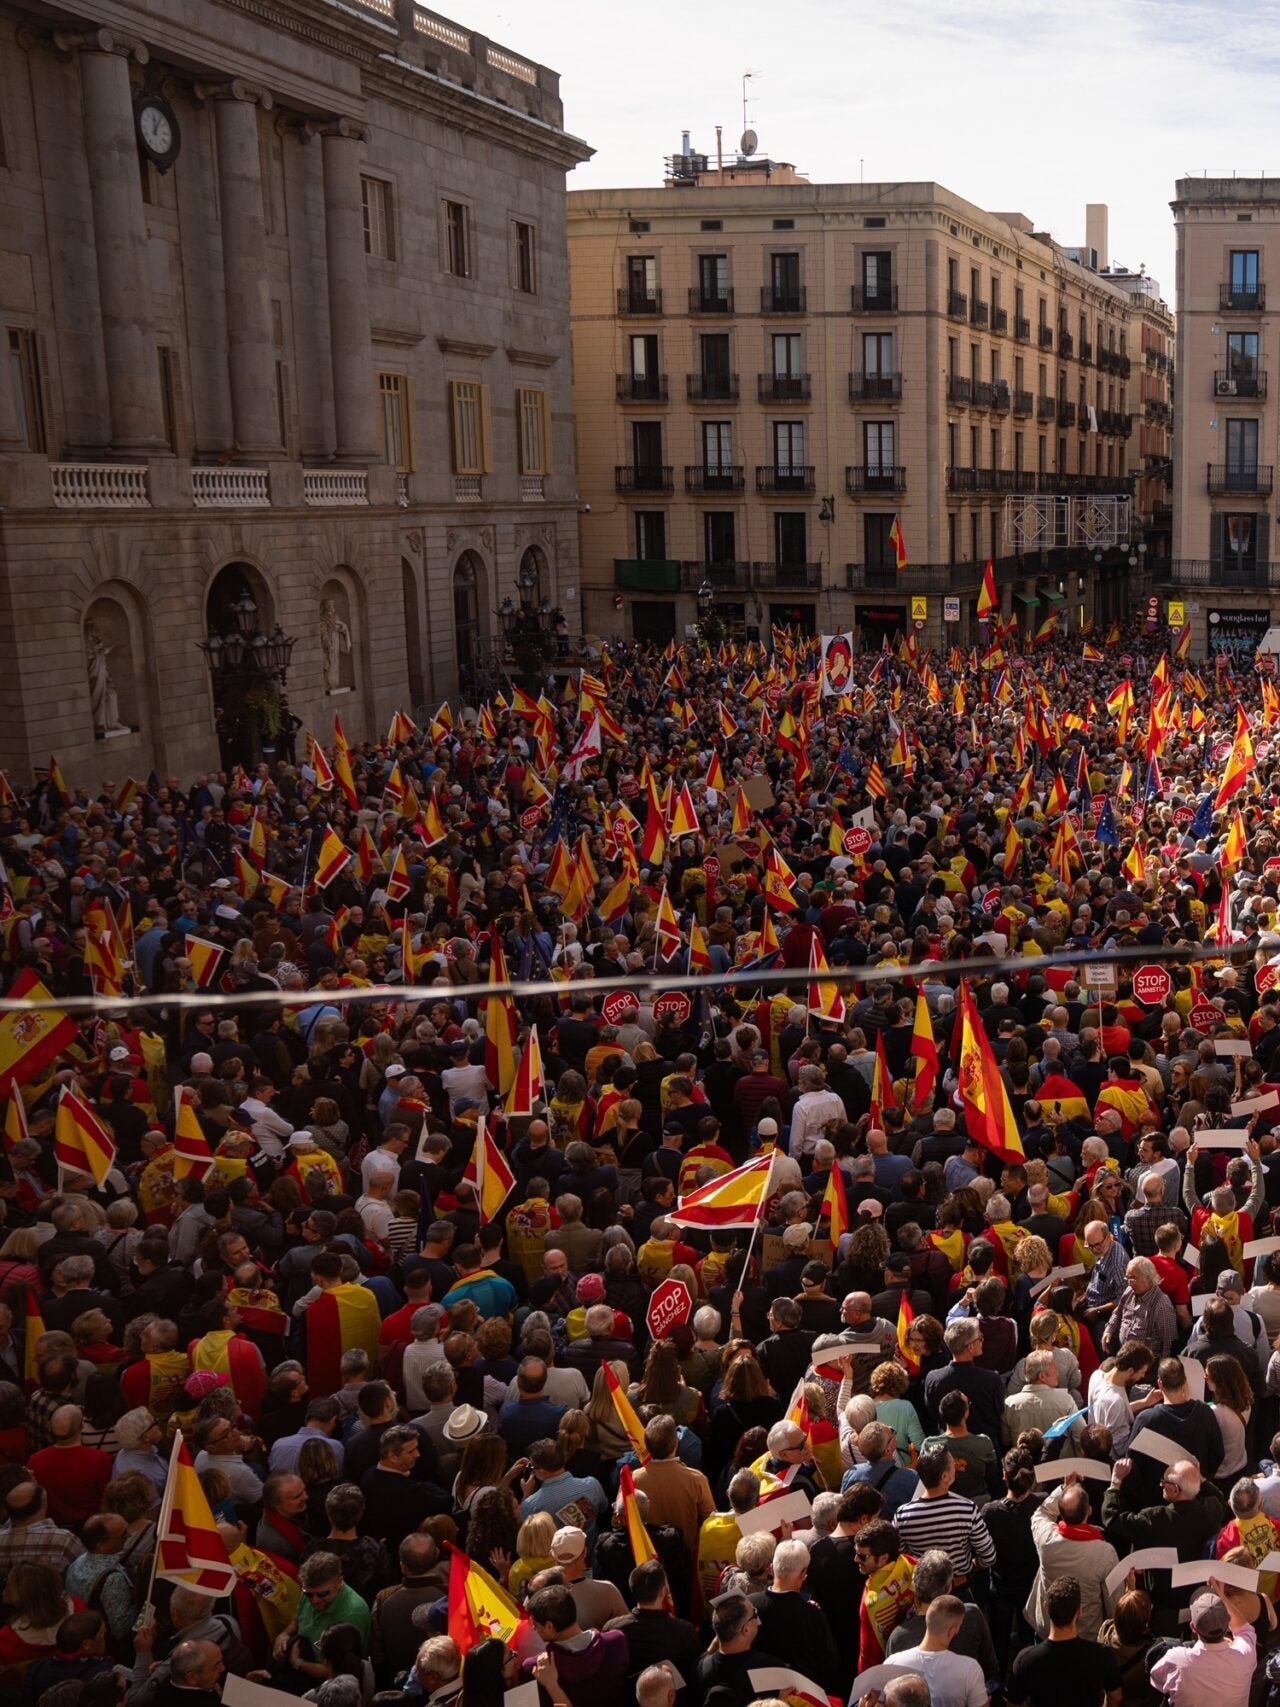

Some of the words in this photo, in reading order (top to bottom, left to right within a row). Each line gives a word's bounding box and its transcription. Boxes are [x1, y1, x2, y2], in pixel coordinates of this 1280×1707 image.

[1222, 614, 1254, 623] sunglass
[1255, 614, 1267, 623] hut
[523, 809, 540, 823] STOP
[1176, 812, 1194, 820] STOP
[847, 832, 868, 845] STOP
[703, 864, 718, 873] STOP
[1137, 975, 1166, 987] STOP
[1137, 985, 1165, 994] AMNISTÍA
[606, 994, 632, 1018] STOP
[657, 1001, 686, 1012] STOP
[1192, 1011, 1222, 1022] STOP
[650, 1288, 682, 1327] STOP
[655, 1301, 687, 1336] SÁNCHEZ
